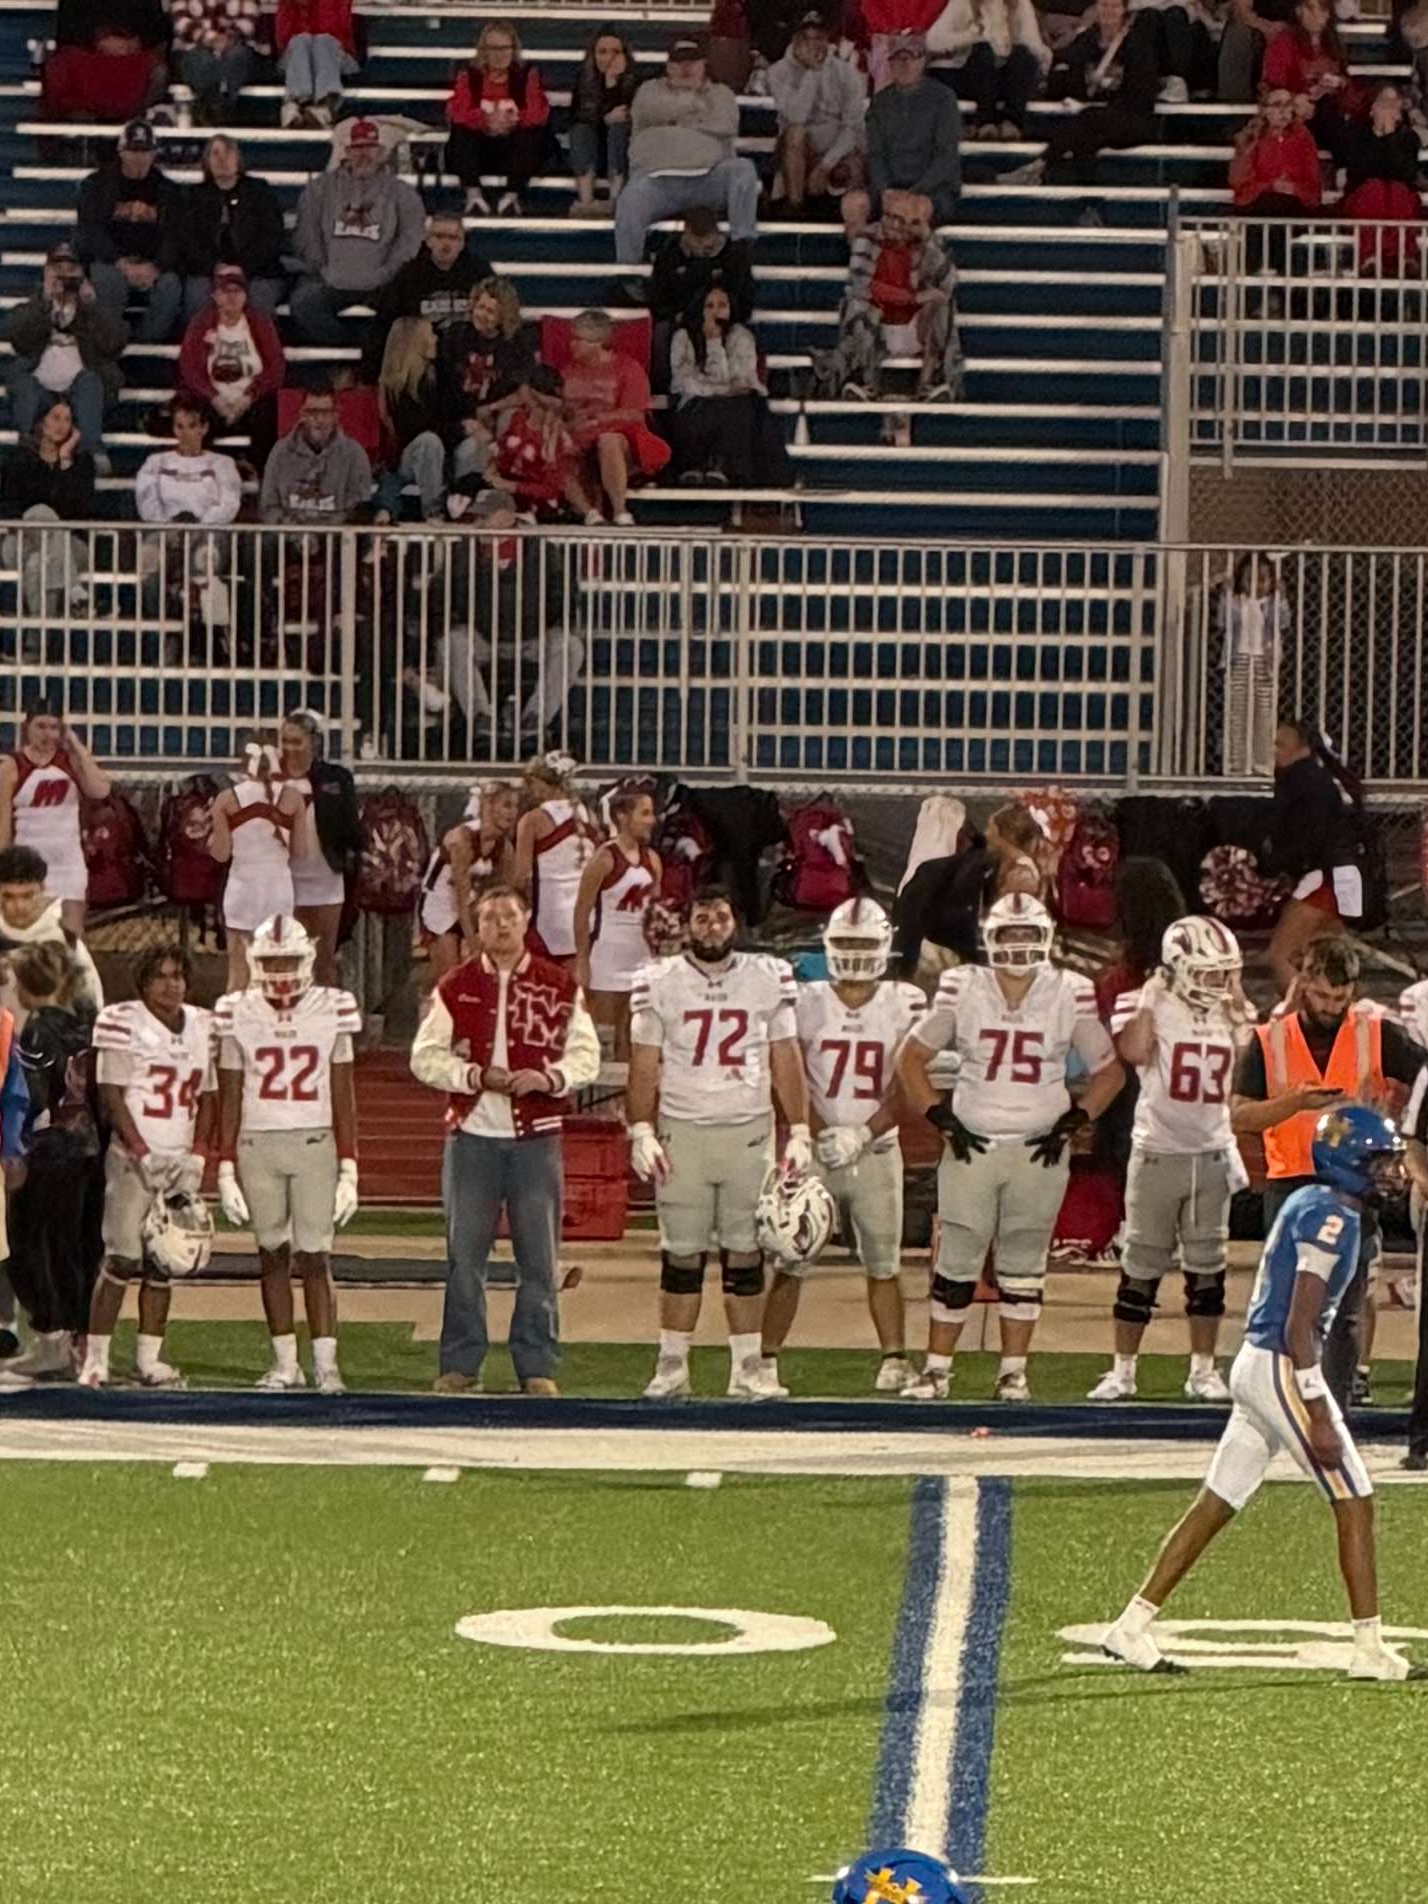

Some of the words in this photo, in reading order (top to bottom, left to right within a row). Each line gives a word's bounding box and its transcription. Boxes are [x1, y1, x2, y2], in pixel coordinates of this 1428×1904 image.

[682, 1008, 750, 1067] 72
[978, 1028, 1045, 1085] 75
[143, 1062, 200, 1120] 34
[255, 1045, 320, 1102] 22
[819, 1040, 885, 1102] 79
[1170, 1042, 1231, 1104] 63
[1316, 1214, 1345, 1245] 2
